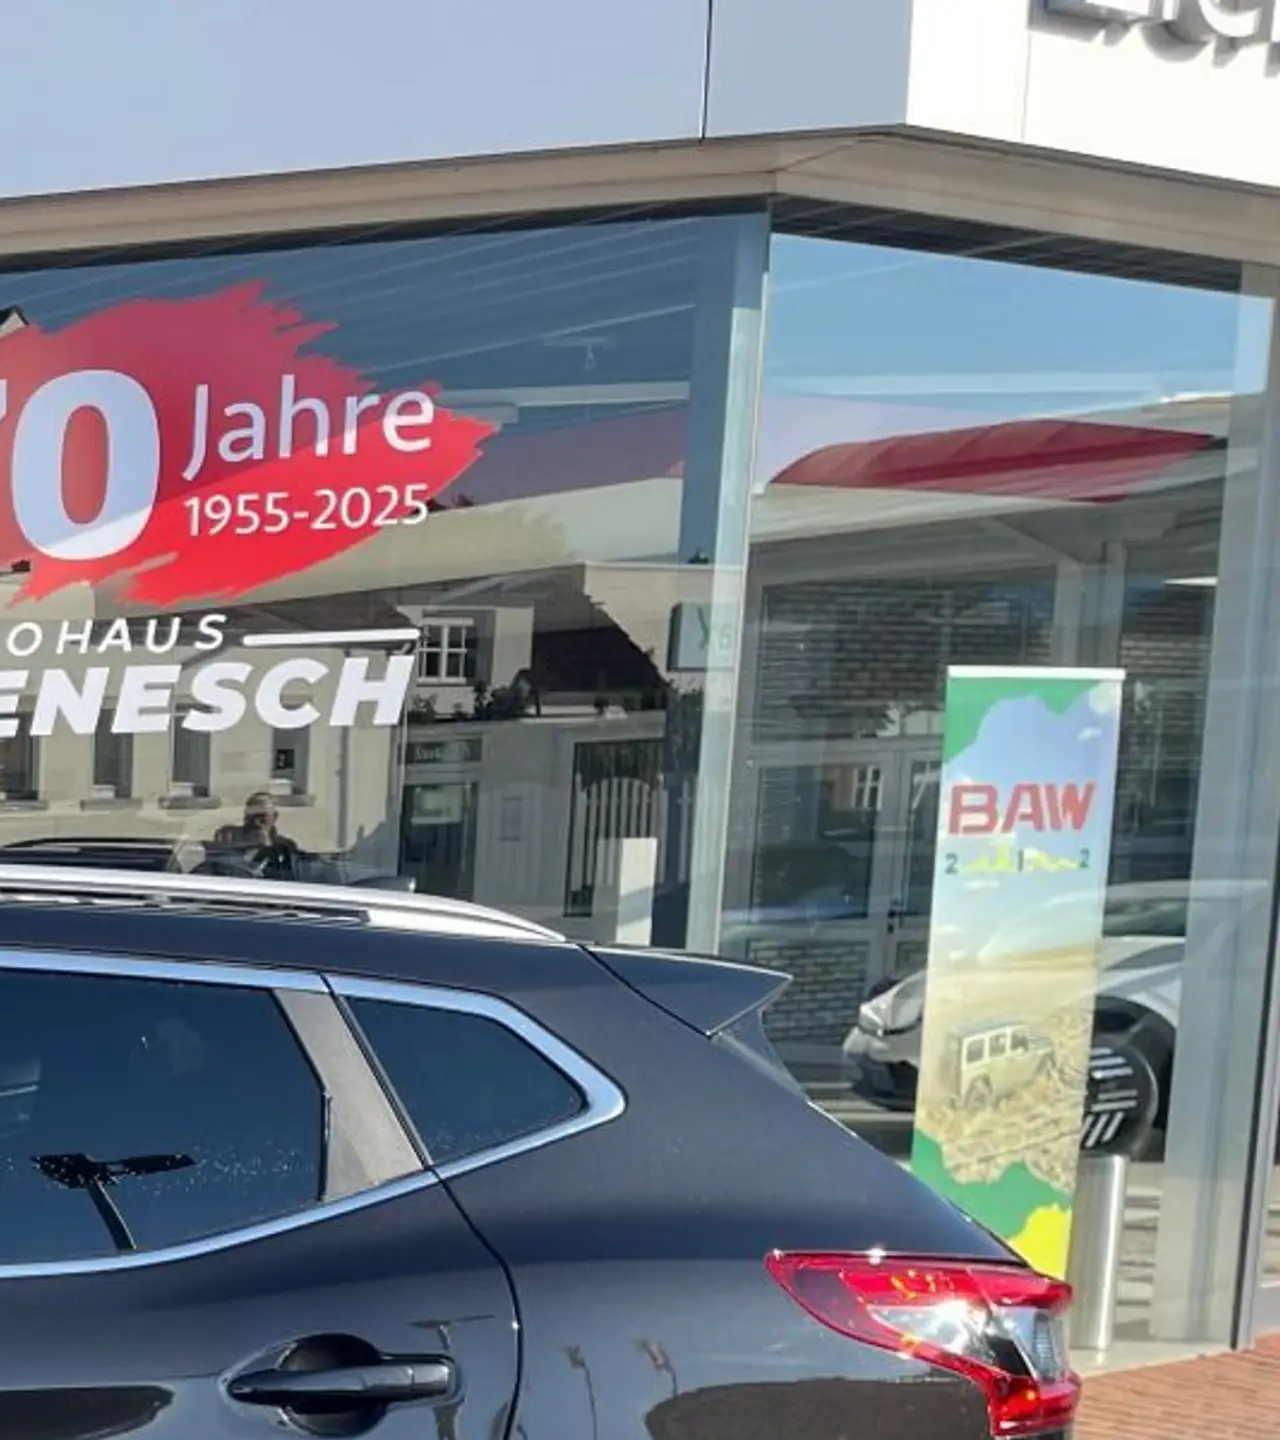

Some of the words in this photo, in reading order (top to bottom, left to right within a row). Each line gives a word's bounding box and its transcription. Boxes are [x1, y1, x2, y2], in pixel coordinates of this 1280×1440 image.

[182, 373, 436, 481] Jahre
[183, 484, 430, 537] 1955-2025
[948, 781, 1098, 835] BAW
